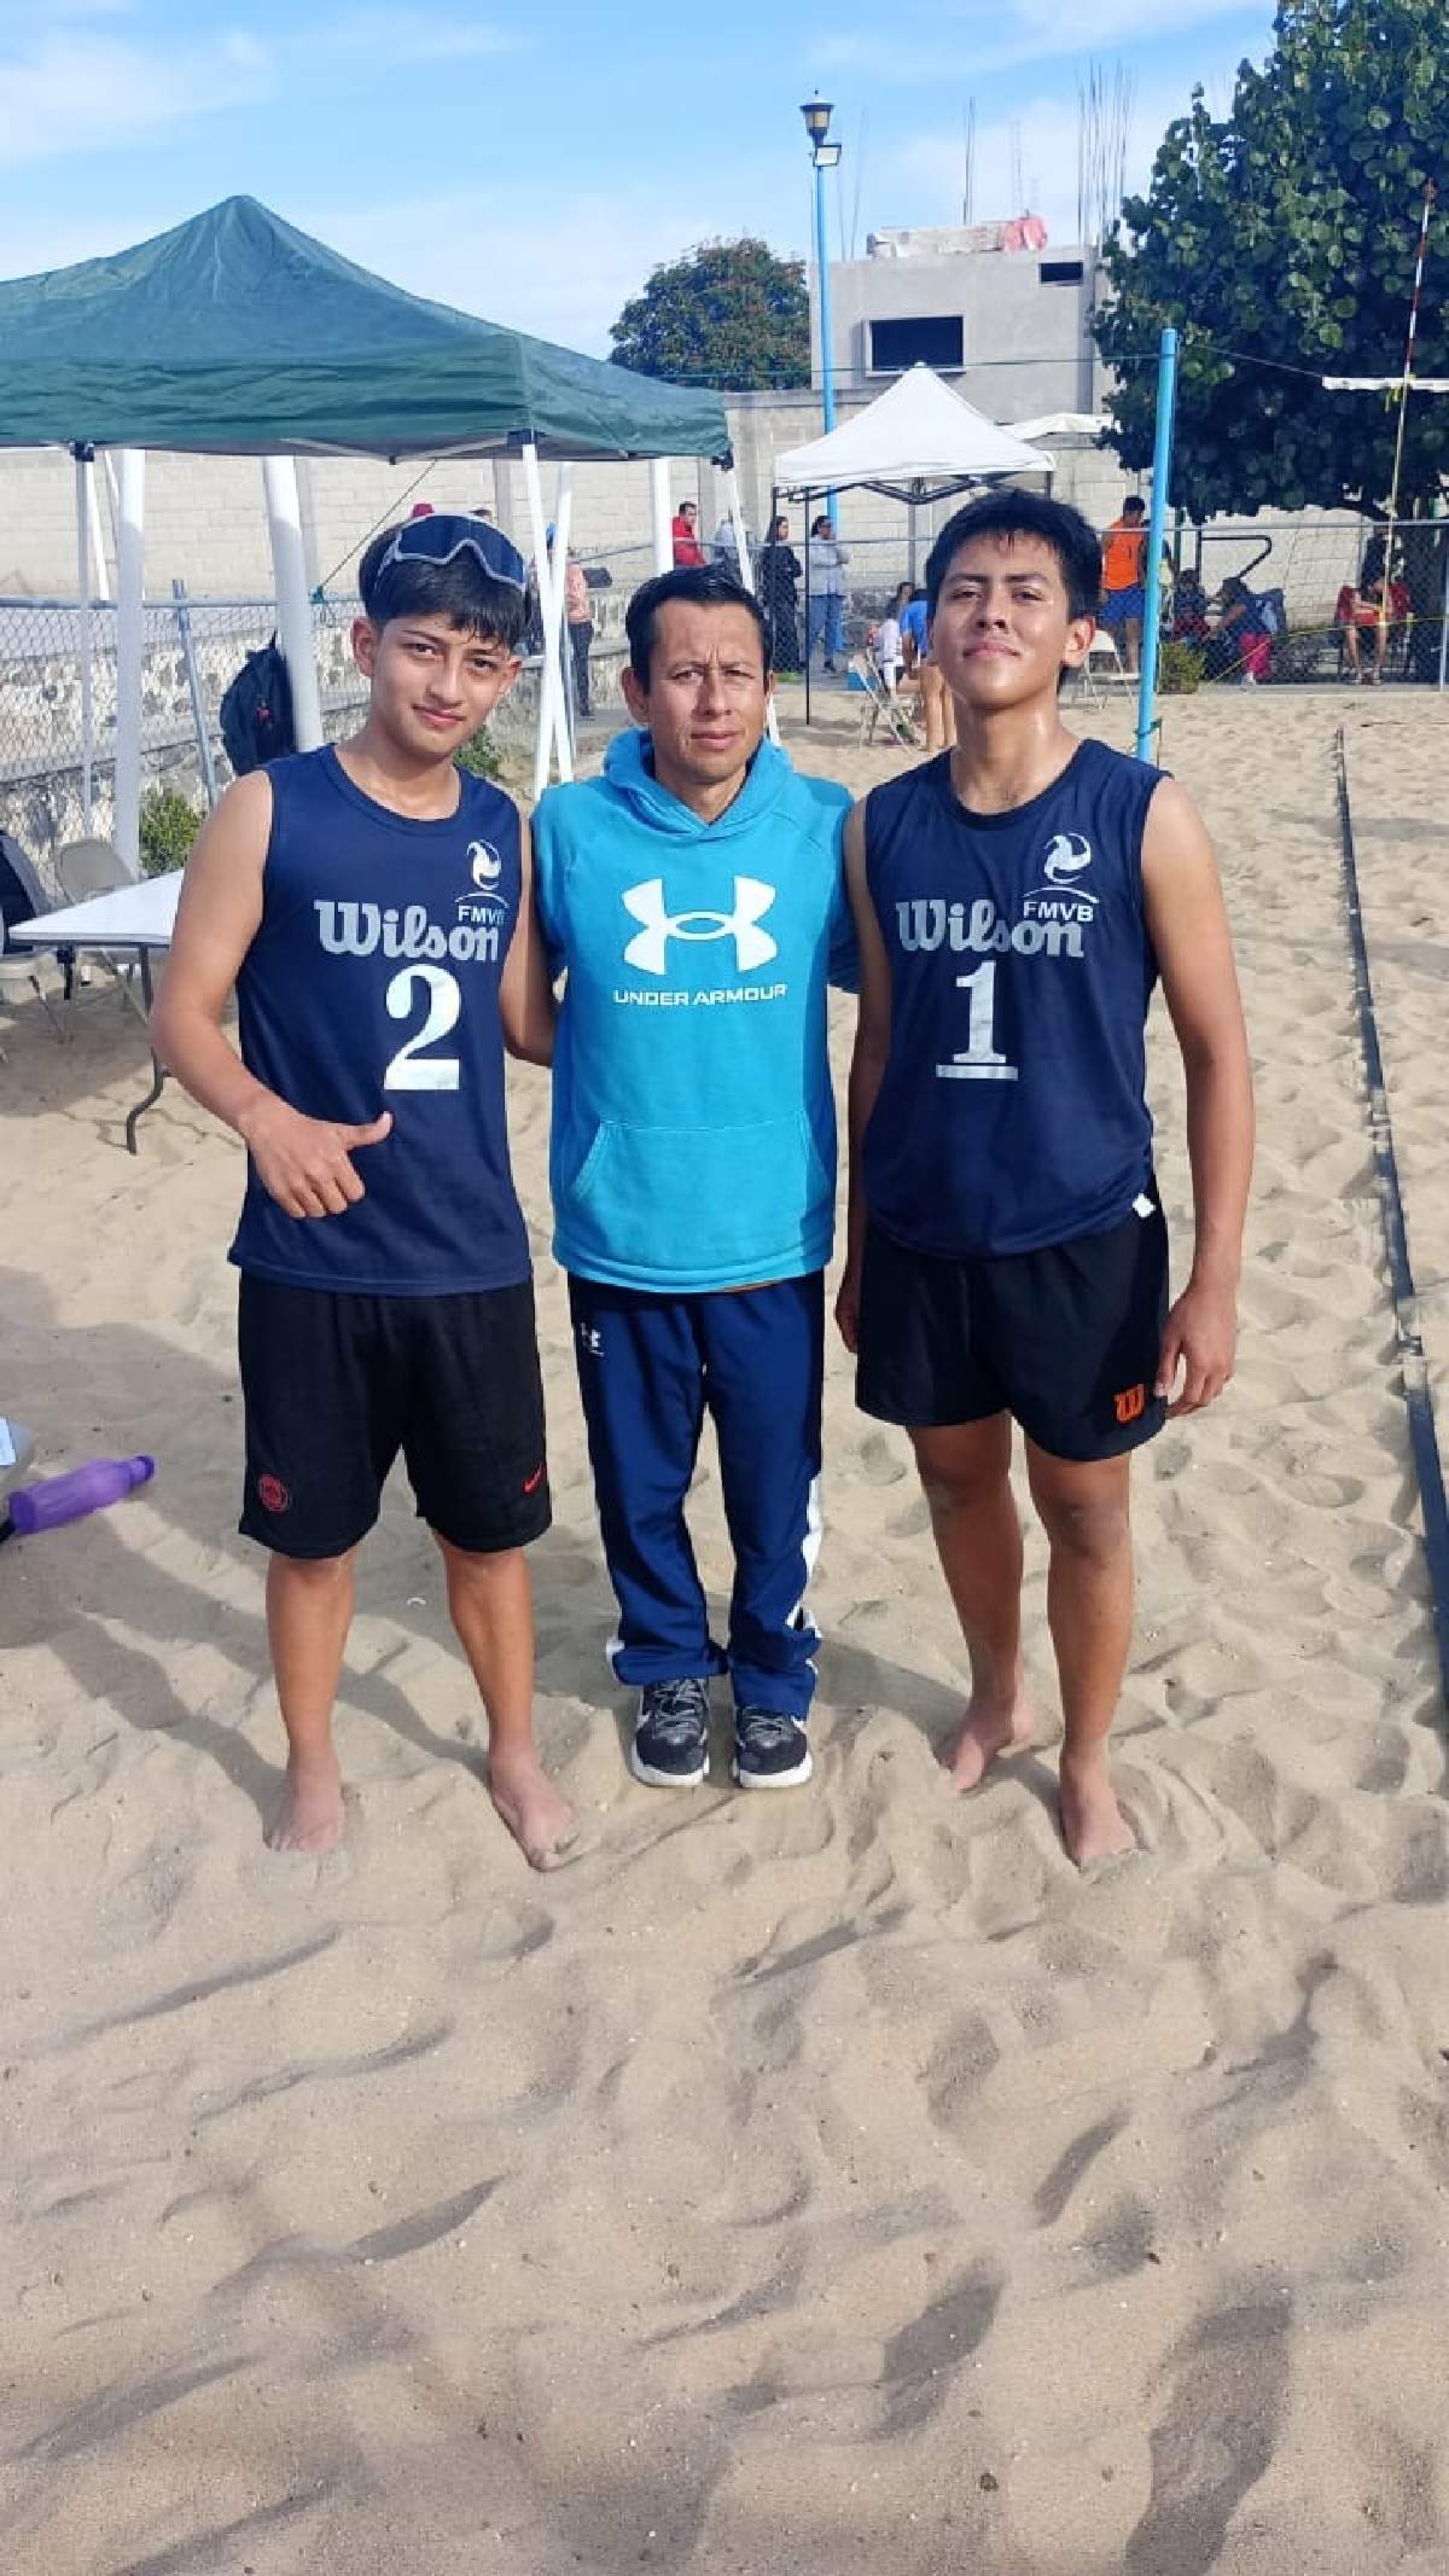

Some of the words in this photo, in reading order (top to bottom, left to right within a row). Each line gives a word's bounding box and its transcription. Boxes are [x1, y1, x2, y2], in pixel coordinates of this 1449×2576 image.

[313, 900, 499, 962] Wilson
[895, 899, 1084, 958] Wilson
[1023, 900, 1094, 922] FMVB
[613, 989, 689, 1005] UNDER
[691, 983, 788, 1005] ARMOUR
[953, 959, 1007, 1063] 1
[383, 963, 462, 1091] 2
